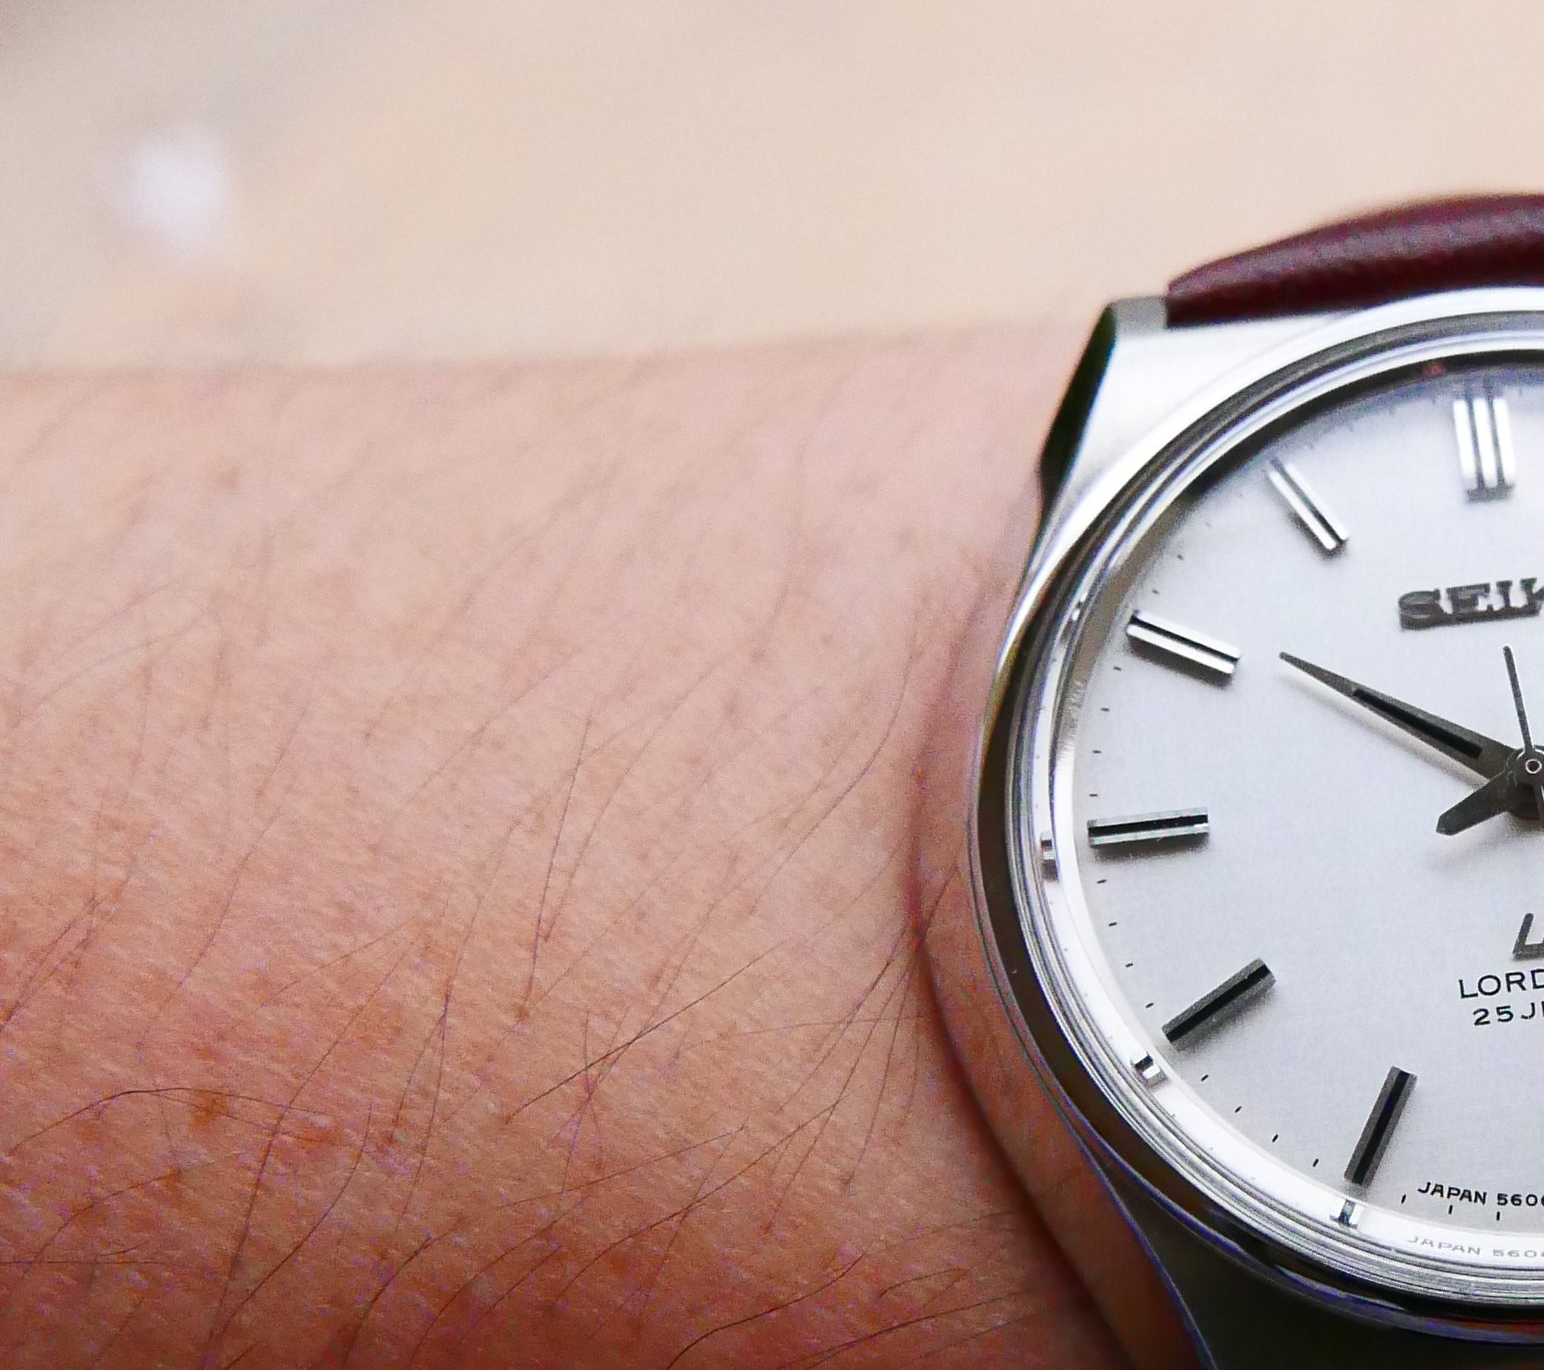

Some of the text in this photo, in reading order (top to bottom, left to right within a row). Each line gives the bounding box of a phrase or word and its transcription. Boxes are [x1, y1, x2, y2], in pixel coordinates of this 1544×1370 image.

[1472, 1005, 1514, 1026] 25
[1417, 1181, 1487, 1205] JAPAN
[1406, 1235, 1481, 1256] JAPAN
